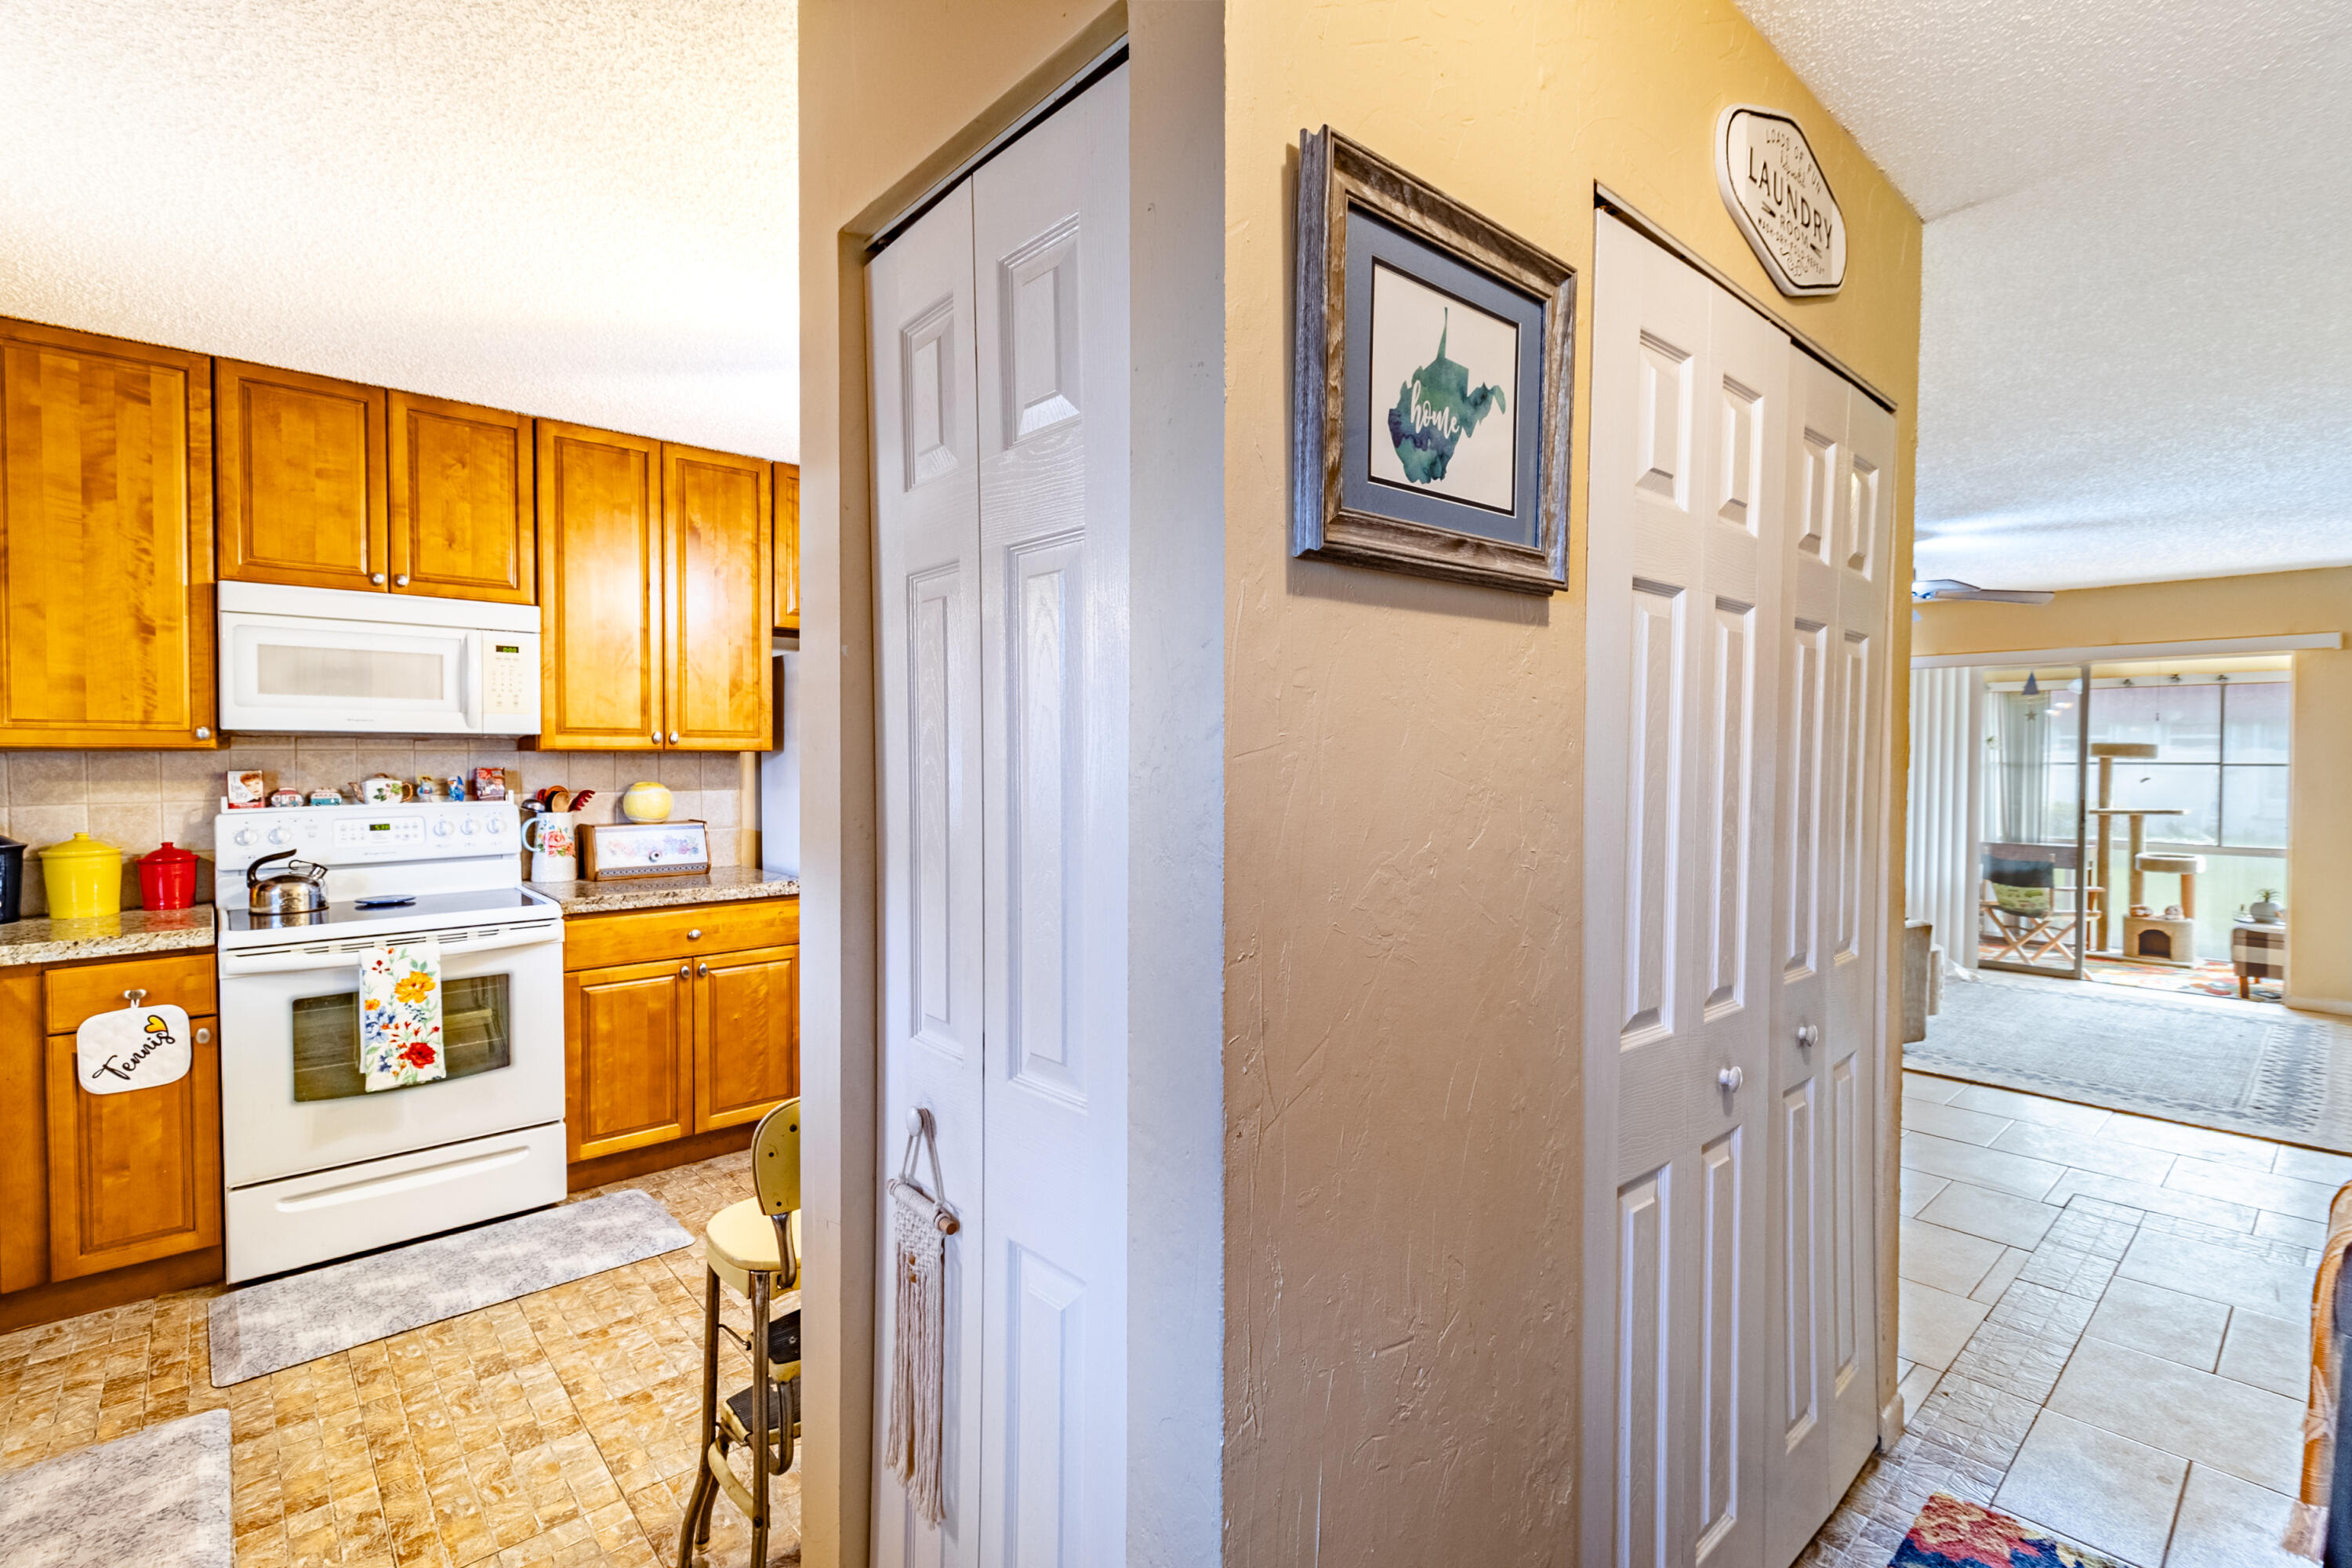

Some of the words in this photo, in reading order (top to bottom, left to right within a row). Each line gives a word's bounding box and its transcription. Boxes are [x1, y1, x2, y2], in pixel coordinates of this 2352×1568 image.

[1748, 146, 1833, 249] LAUNDRY
[1780, 213, 1809, 249] ROOM
[1410, 379, 1461, 440] home
[92, 1031, 176, 1080] Tennis
